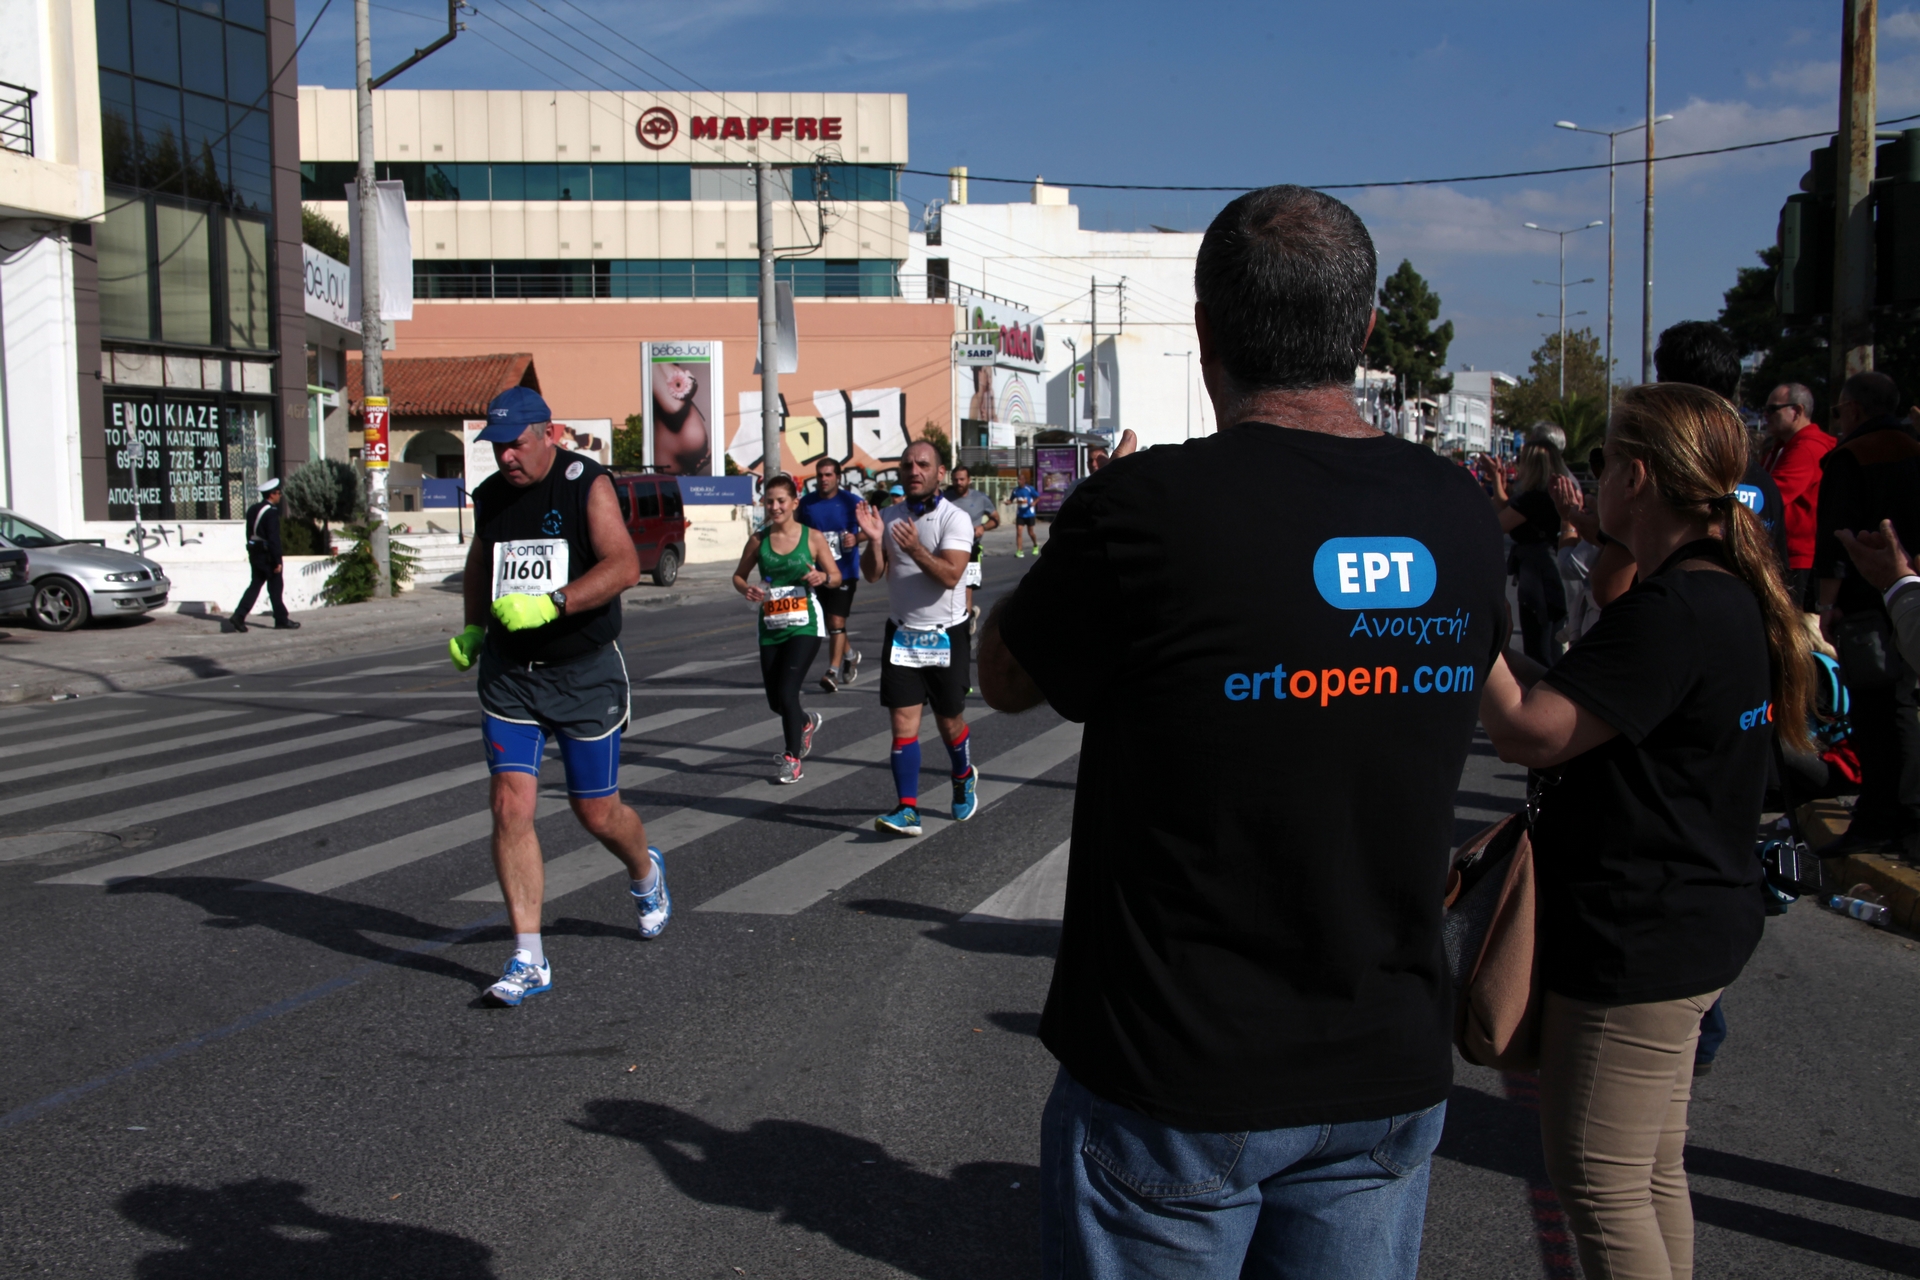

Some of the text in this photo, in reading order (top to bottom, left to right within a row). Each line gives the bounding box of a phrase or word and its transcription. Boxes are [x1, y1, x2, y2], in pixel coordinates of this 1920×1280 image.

[690, 116, 842, 140] MAPFRE
[967, 349, 993, 358] SARP
[367, 412, 384, 424] 17
[105, 429, 120, 446] ΤΟ
[166, 430, 220, 447] ΚΑΤΑΣΤΗΜΑ
[146, 451, 160, 468] 58
[169, 451, 195, 468] 7275
[203, 451, 222, 468] 210
[169, 470, 202, 485] ΠΑΤΑΡΙ
[191, 486, 223, 502] ΘΕΣΕΙΣ
[503, 561, 552, 580] 11601
[767, 598, 800, 613] 8208
[1349, 608, 1470, 645] Ανοιχτή!
[902, 632, 939, 648] 3789
[1223, 663, 1475, 707] ertopen.com
